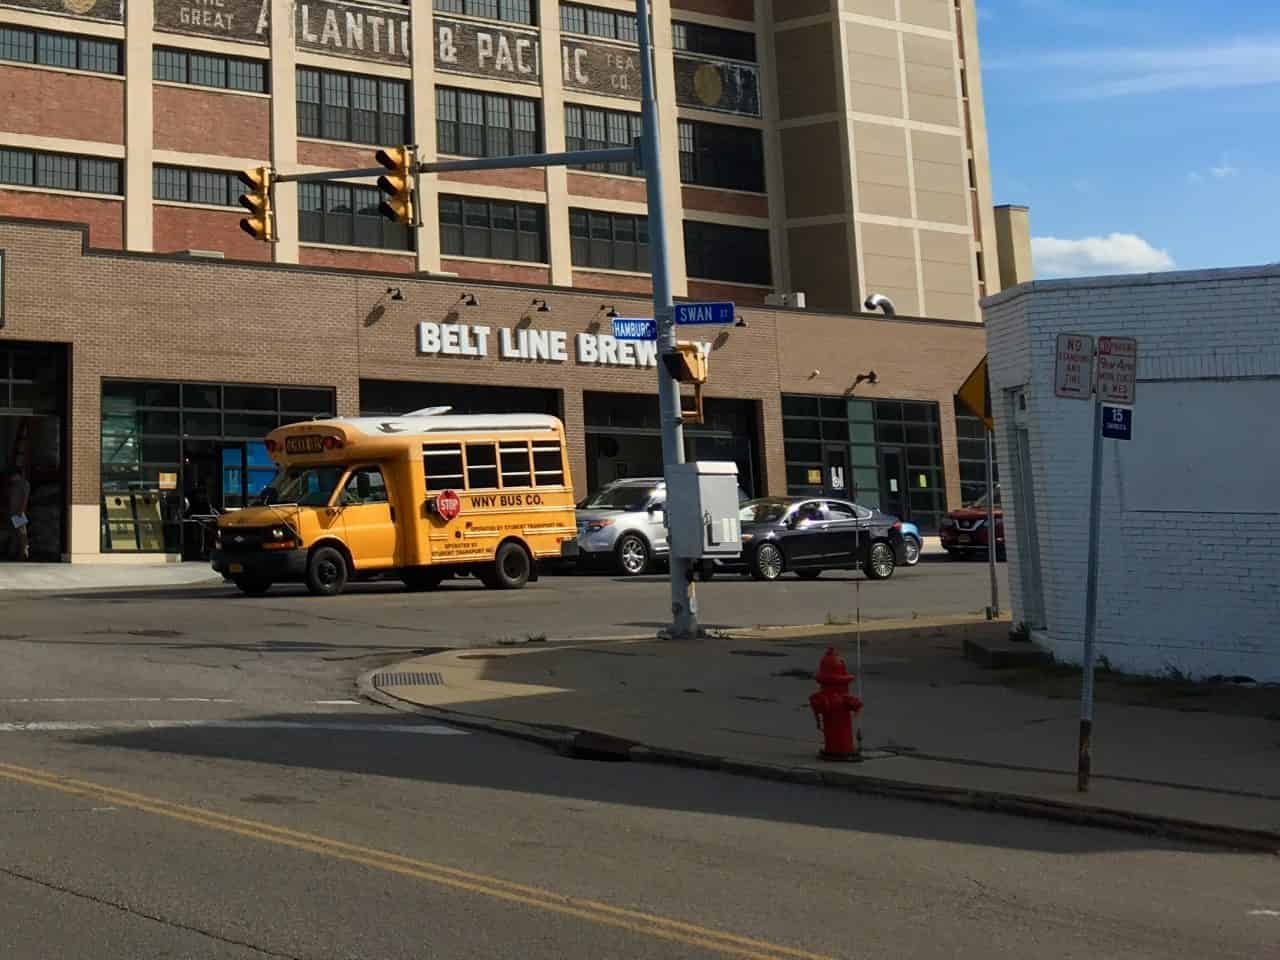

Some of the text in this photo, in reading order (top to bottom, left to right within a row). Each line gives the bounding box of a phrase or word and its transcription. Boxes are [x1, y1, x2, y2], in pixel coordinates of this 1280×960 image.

[179, 7, 235, 31] GREAT
[439, 26, 458, 64] &
[477, 31, 589, 85] PACIIC
[680, 306, 713, 321] SWAN
[614, 321, 651, 338] HAMBURG
[420, 320, 490, 357] BELT
[501, 326, 568, 362] LINE
[440, 498, 459, 511] STOP
[471, 494, 544, 508] WNY BUS CO.
